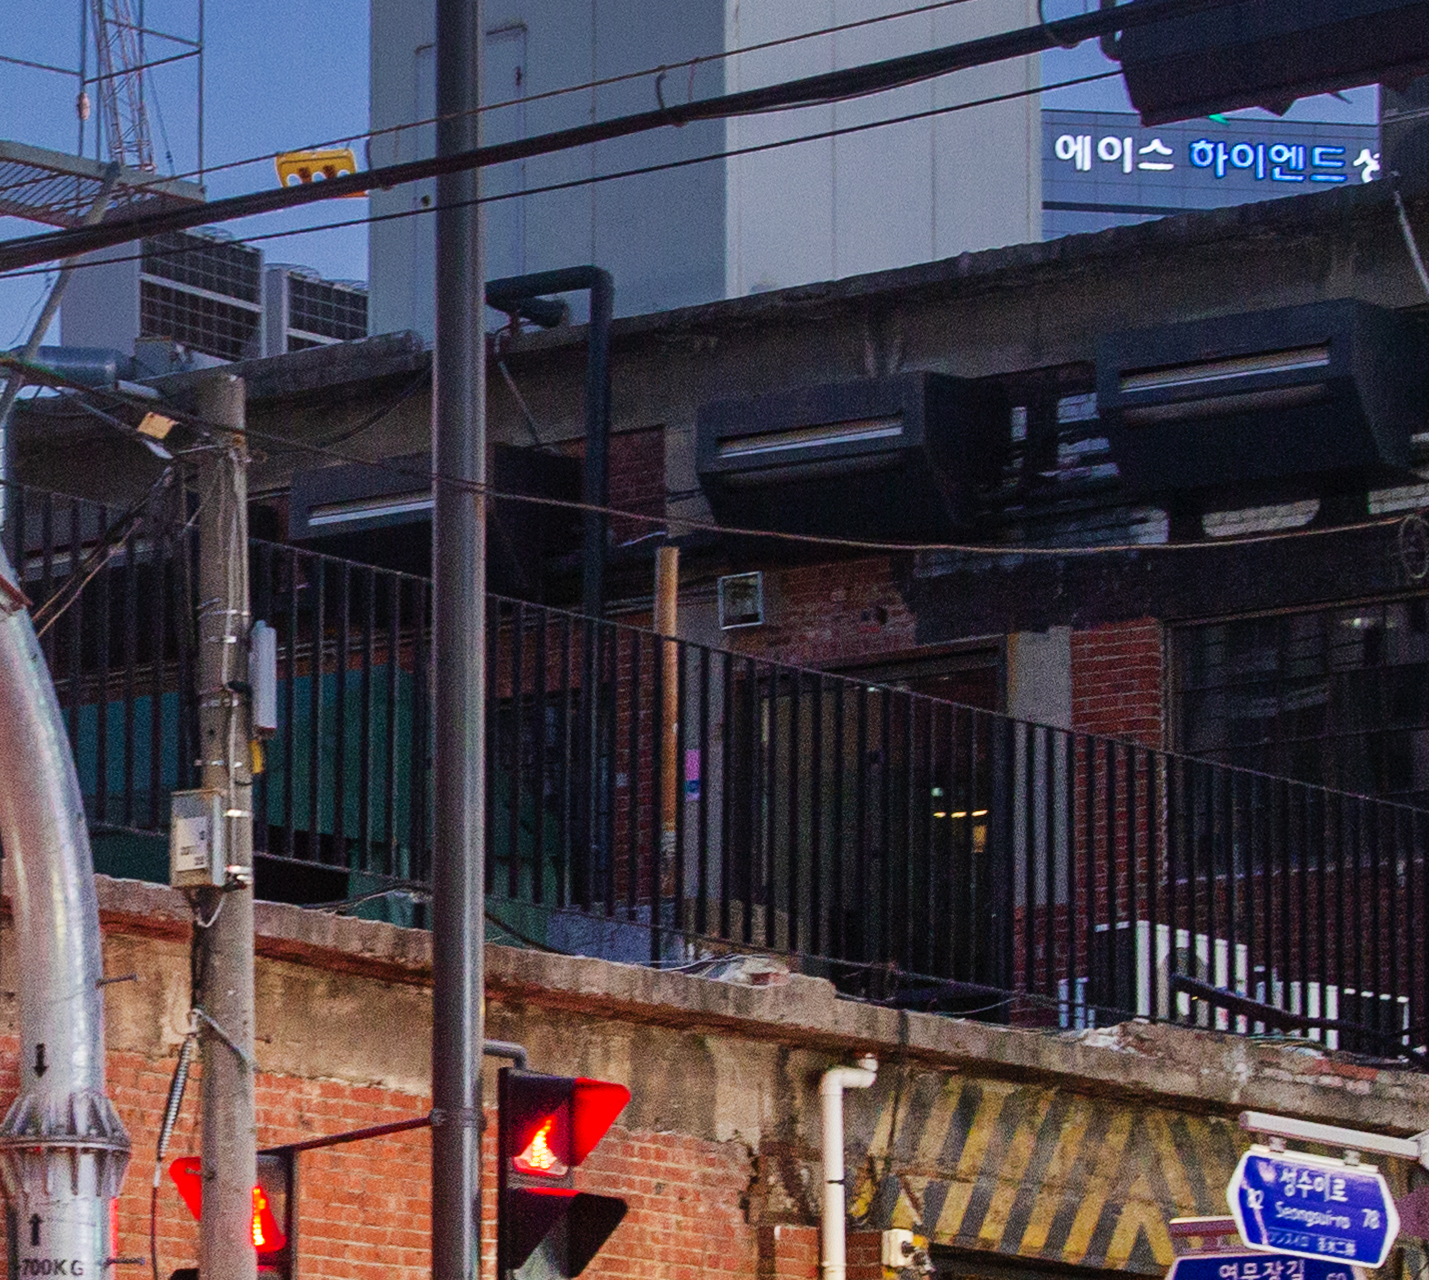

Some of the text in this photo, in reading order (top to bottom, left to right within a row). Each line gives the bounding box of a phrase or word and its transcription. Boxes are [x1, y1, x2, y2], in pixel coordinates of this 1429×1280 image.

[1054, 134, 1175, 173] 에이스
[1191, 138, 1347, 182] 하이엔드
[1279, 1168, 1348, 1202] 성수이로
[1361, 1208, 1380, 1229] 78
